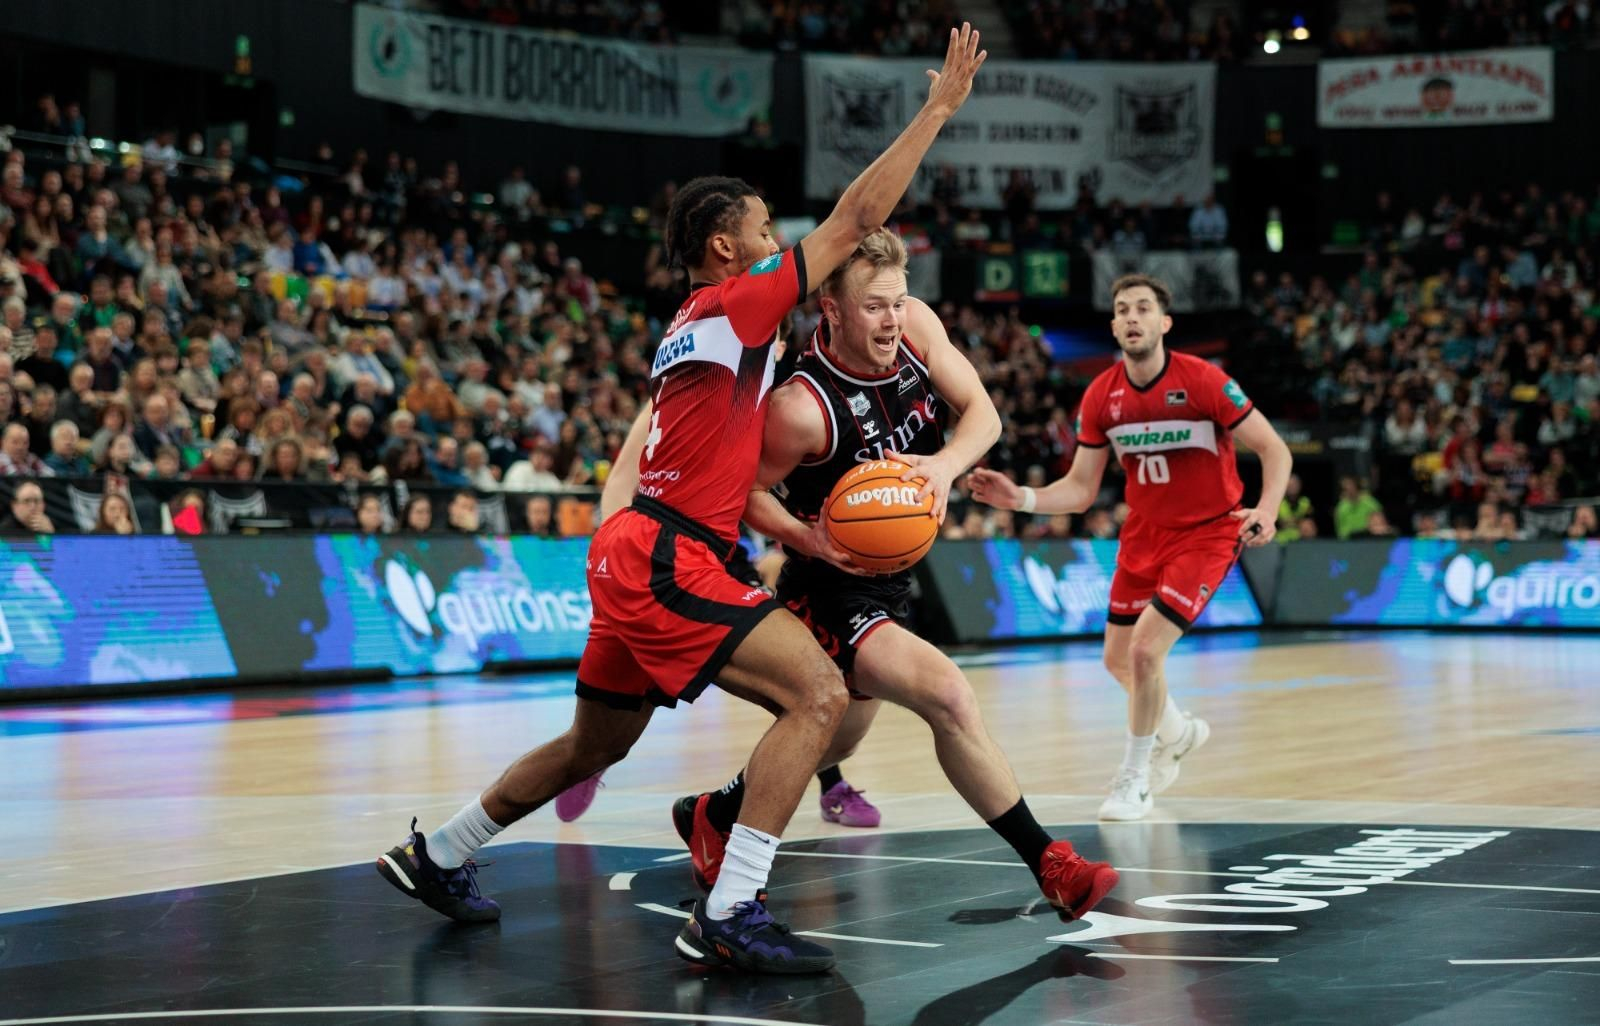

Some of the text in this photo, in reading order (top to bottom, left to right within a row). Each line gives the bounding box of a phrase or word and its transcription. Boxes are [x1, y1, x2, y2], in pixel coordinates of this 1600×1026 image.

[427, 24, 496, 98] BETI
[1136, 454, 1171, 486] 70
[846, 486, 923, 507] Wilson
